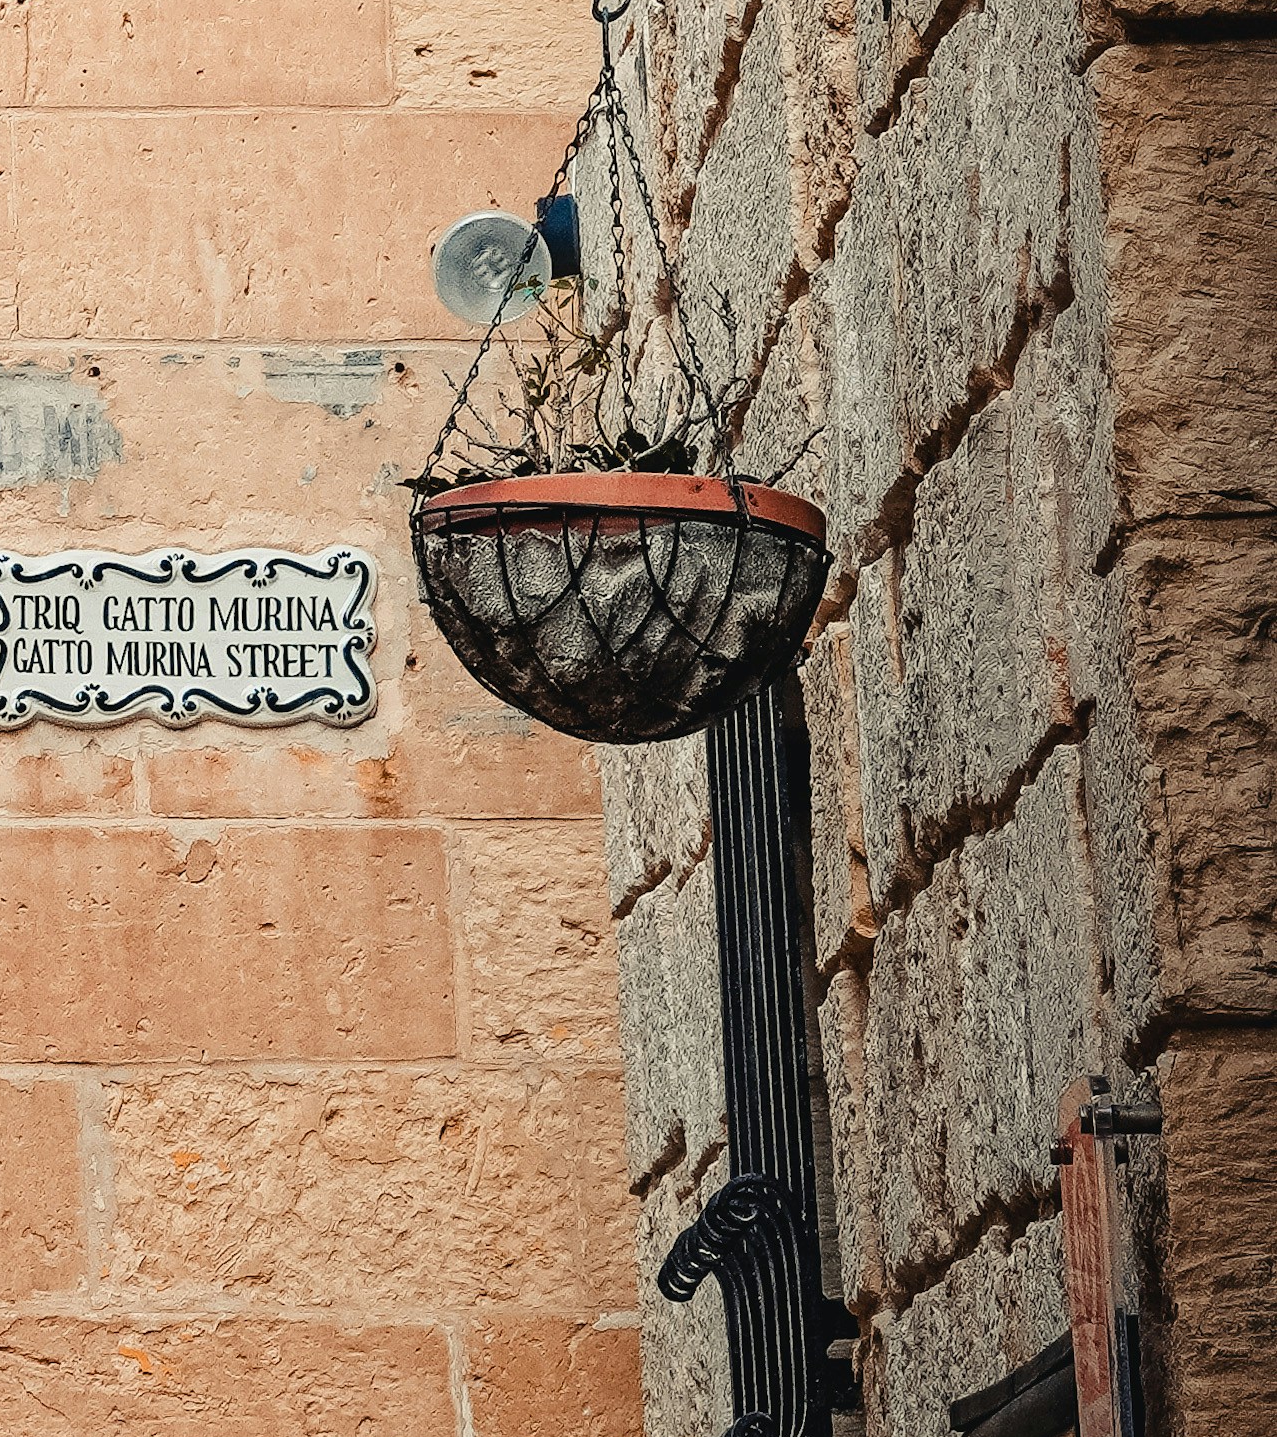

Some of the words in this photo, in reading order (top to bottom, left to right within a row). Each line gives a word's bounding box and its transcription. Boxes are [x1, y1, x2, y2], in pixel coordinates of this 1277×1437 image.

[12, 594, 84, 635] TRIQ
[102, 595, 195, 632] GATTO
[208, 596, 340, 632] MURINA
[13, 637, 93, 675] GATTO
[106, 641, 217, 678] MURINA
[226, 643, 339, 678] STREET
